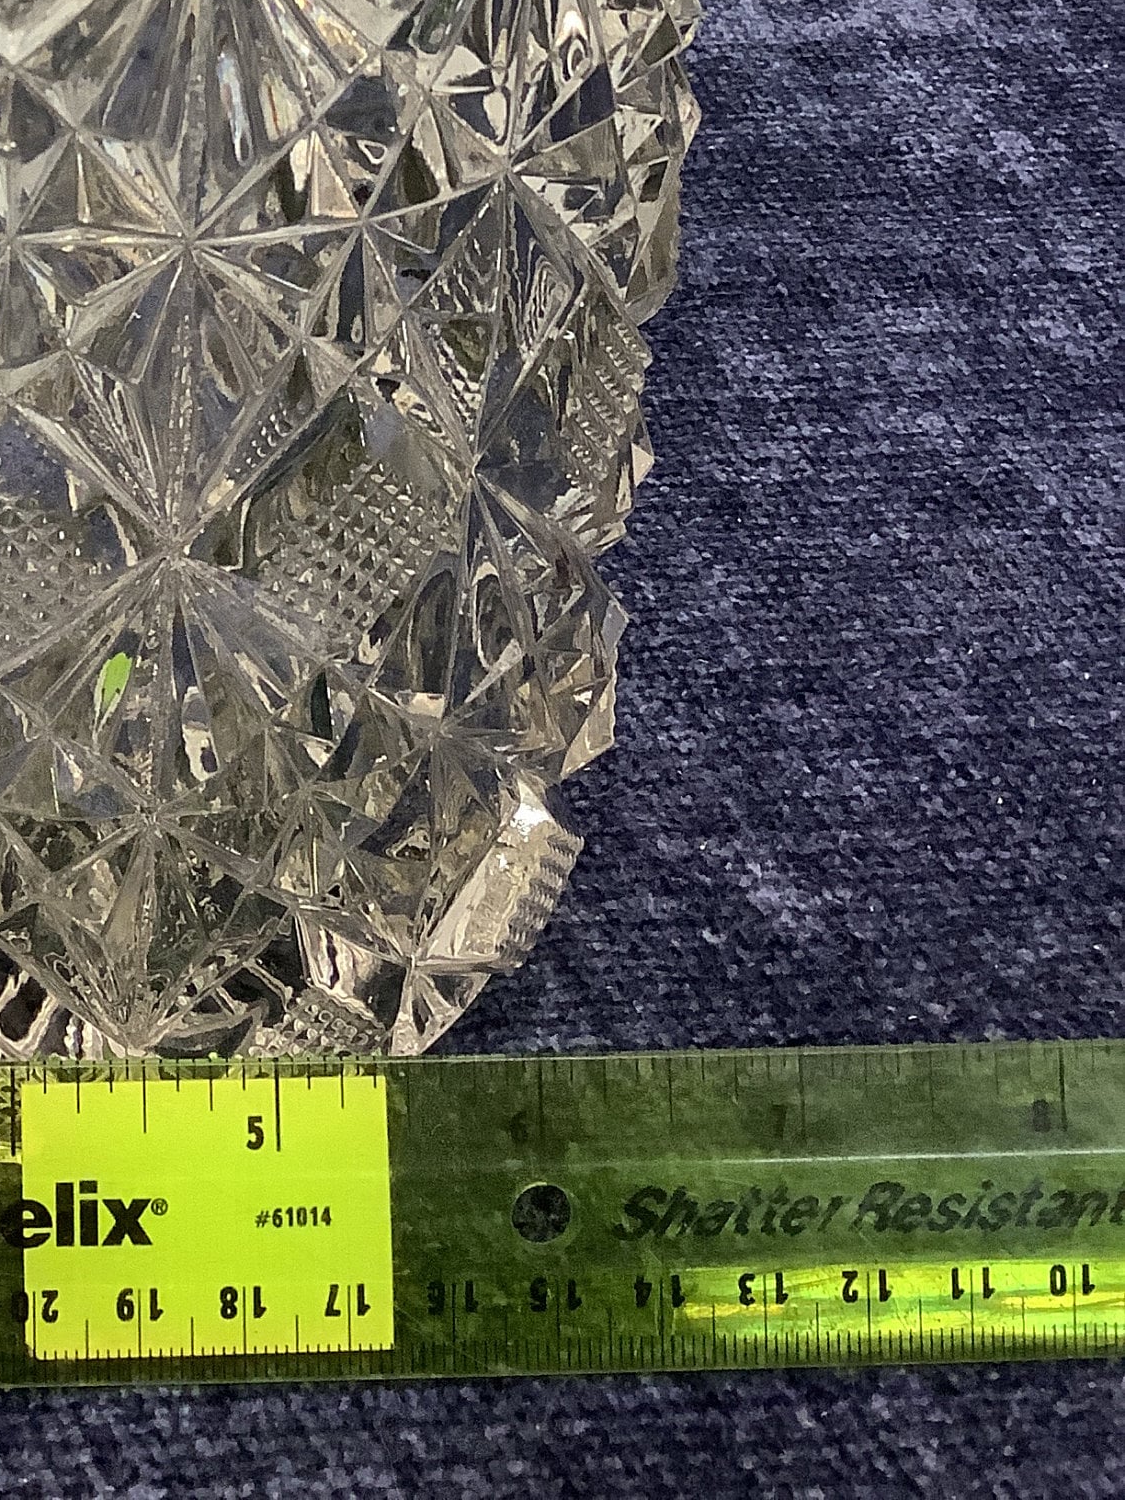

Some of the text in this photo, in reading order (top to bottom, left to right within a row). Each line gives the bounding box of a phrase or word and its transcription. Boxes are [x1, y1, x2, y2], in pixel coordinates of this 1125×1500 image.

[246, 1116, 264, 1151] 5
[255, 1206, 332, 1230] #61014
[612, 1185, 843, 1241] Shatter
[529, 1277, 582, 1312] 15
[633, 1274, 686, 1309] 14
[738, 1272, 789, 1306] 13
[841, 1269, 893, 1303] 12
[951, 1267, 995, 1300] 11
[1049, 1264, 1096, 1296] 10
[11, 1290, 59, 1324] 20
[117, 1288, 163, 1321] 19
[220, 1286, 267, 1320] 18
[324, 1284, 371, 1318] 17
[427, 1280, 476, 1315] 16
